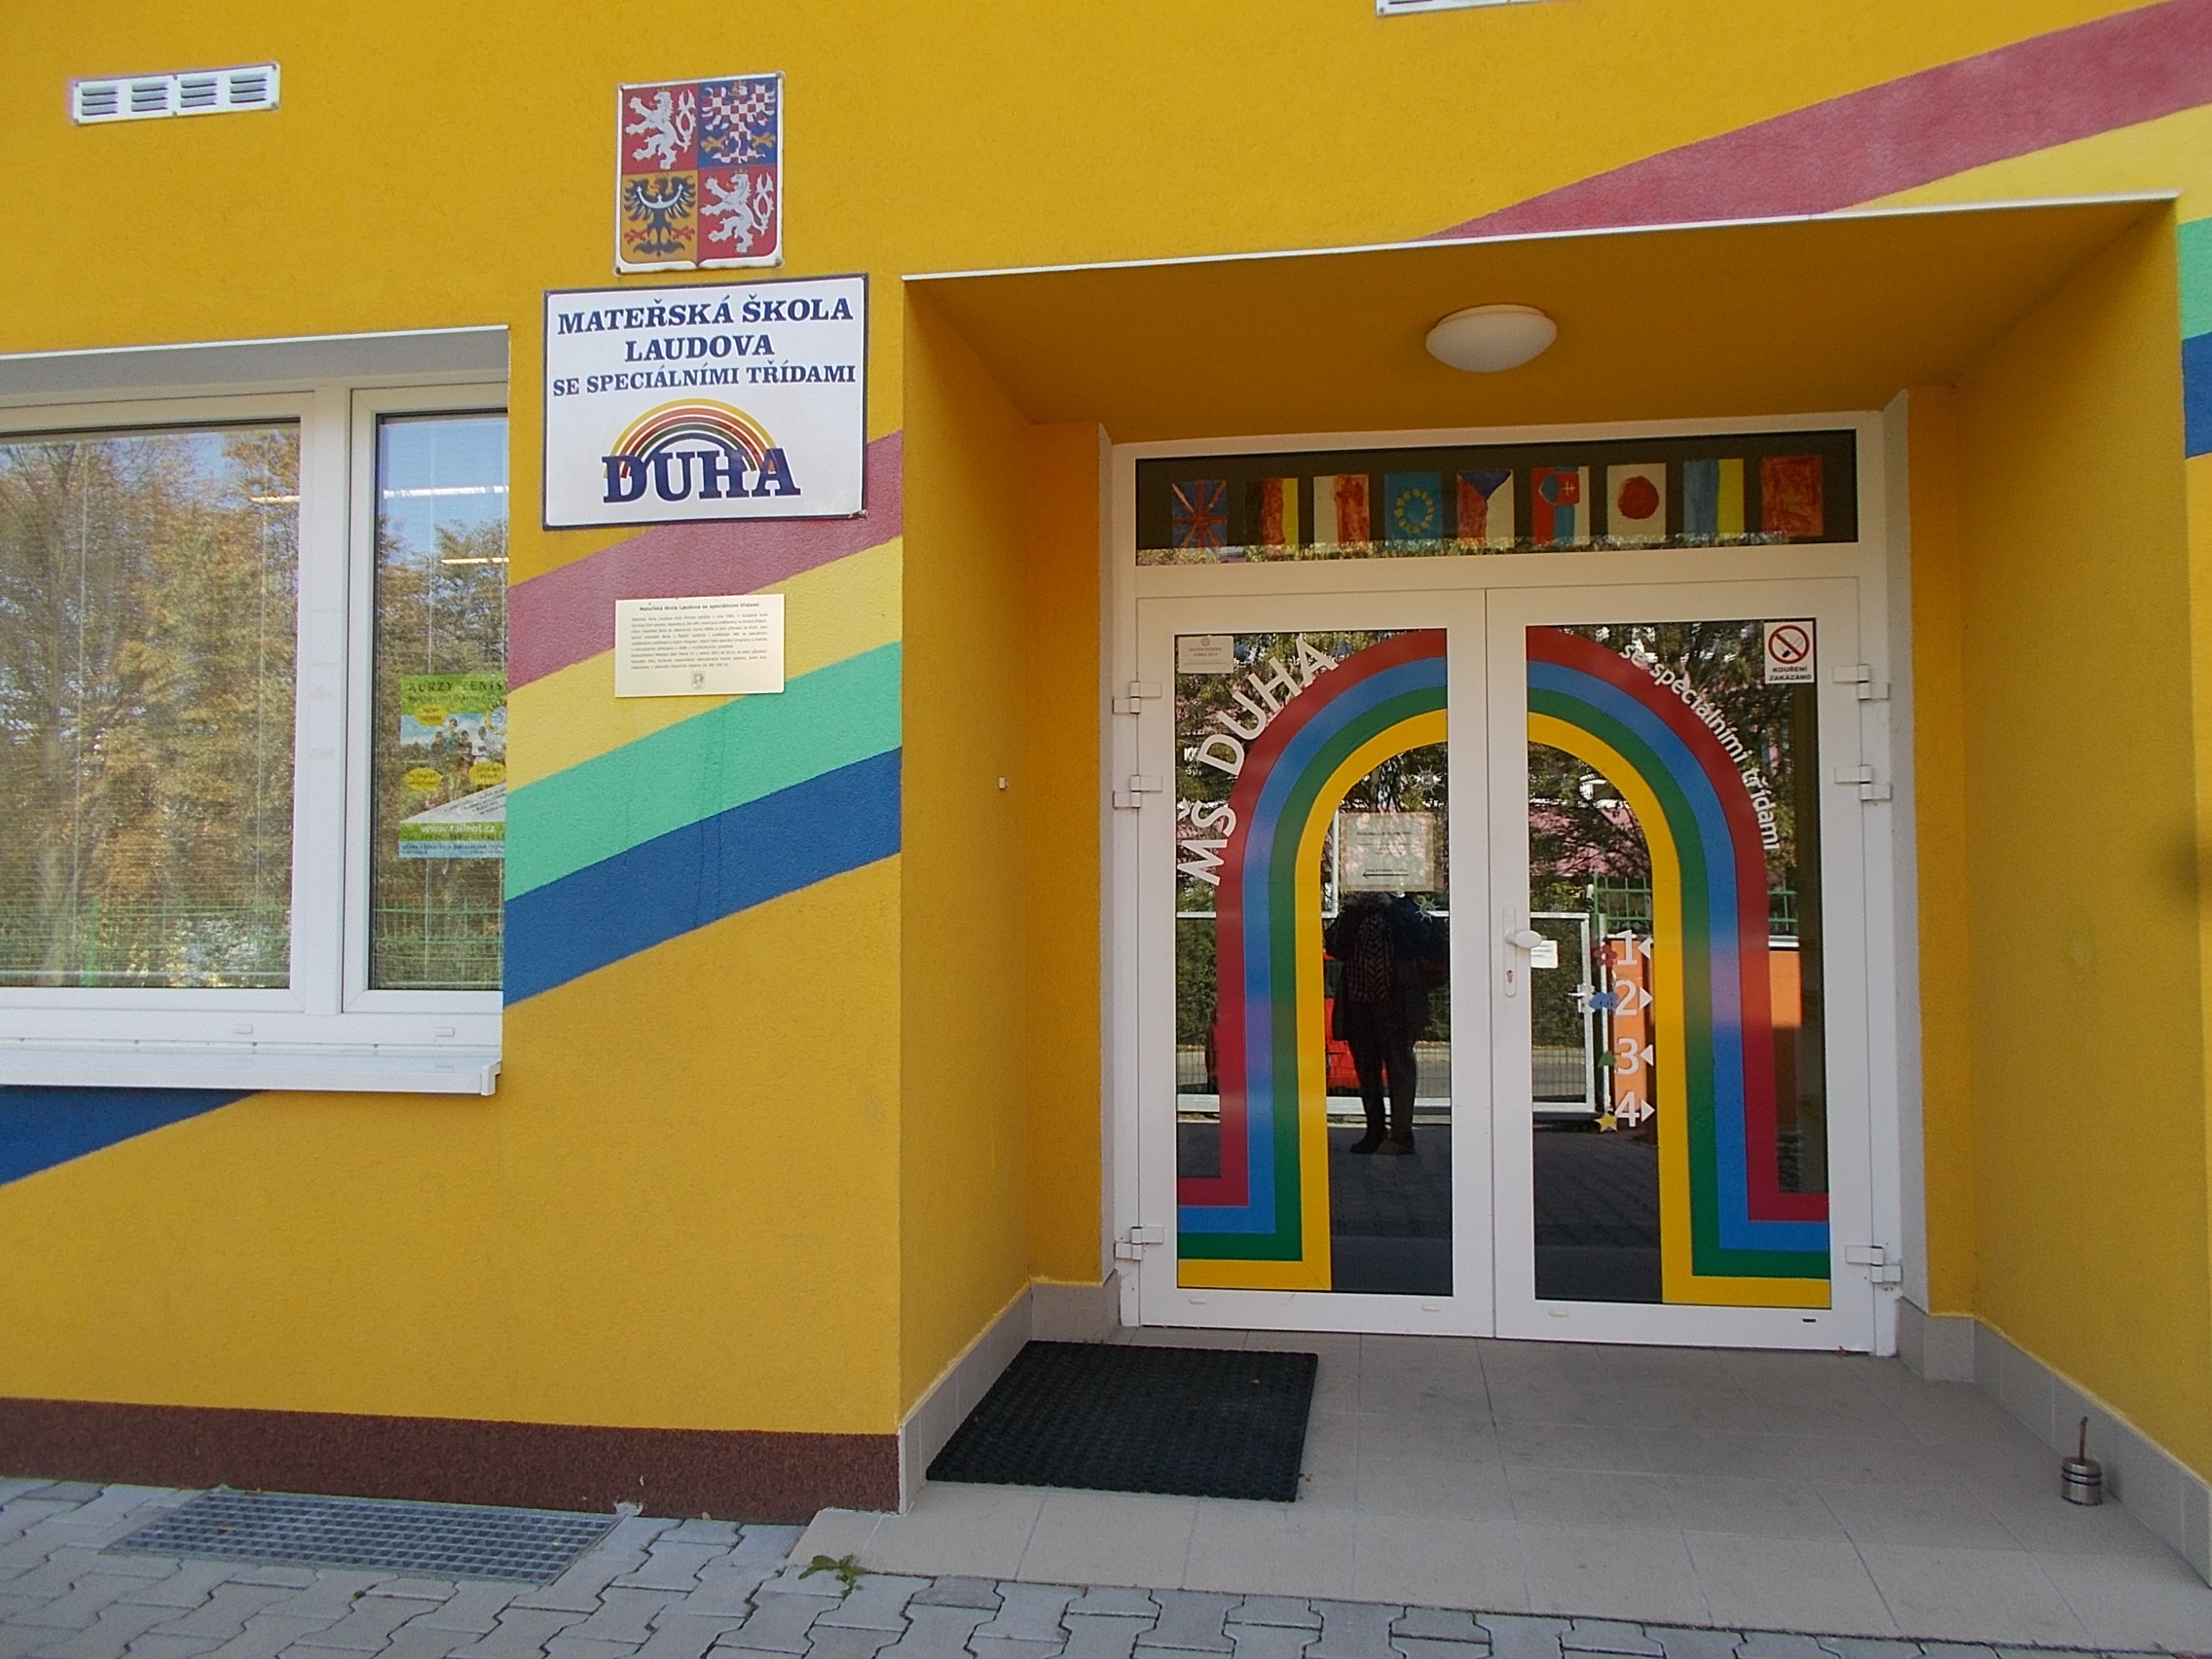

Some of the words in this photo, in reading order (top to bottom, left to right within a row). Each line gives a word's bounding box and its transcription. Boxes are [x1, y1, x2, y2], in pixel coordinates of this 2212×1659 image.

[558, 295, 734, 335] MATEŘSKÁ
[742, 294, 853, 323] ŠKOLA
[625, 334, 775, 362] LAUDOVA
[553, 378, 579, 396] SE
[587, 362, 739, 393] SPECIÁLNÍMI
[747, 359, 856, 384] TŘÍDAMI
[602, 448, 801, 503] DUHA
[409, 682, 453, 692] KURZY
[1197, 638, 1340, 776] DUHA
[1618, 644, 1651, 673] se
[1648, 662, 1753, 763] speciálními
[1741, 767, 1781, 850] třídami
[1176, 797, 1236, 886] MŠ
[1618, 930, 1638, 965] 1
[1615, 979, 1638, 1015] 2
[1617, 1037, 1640, 1075] 3
[1615, 1090, 1641, 1126] 4
